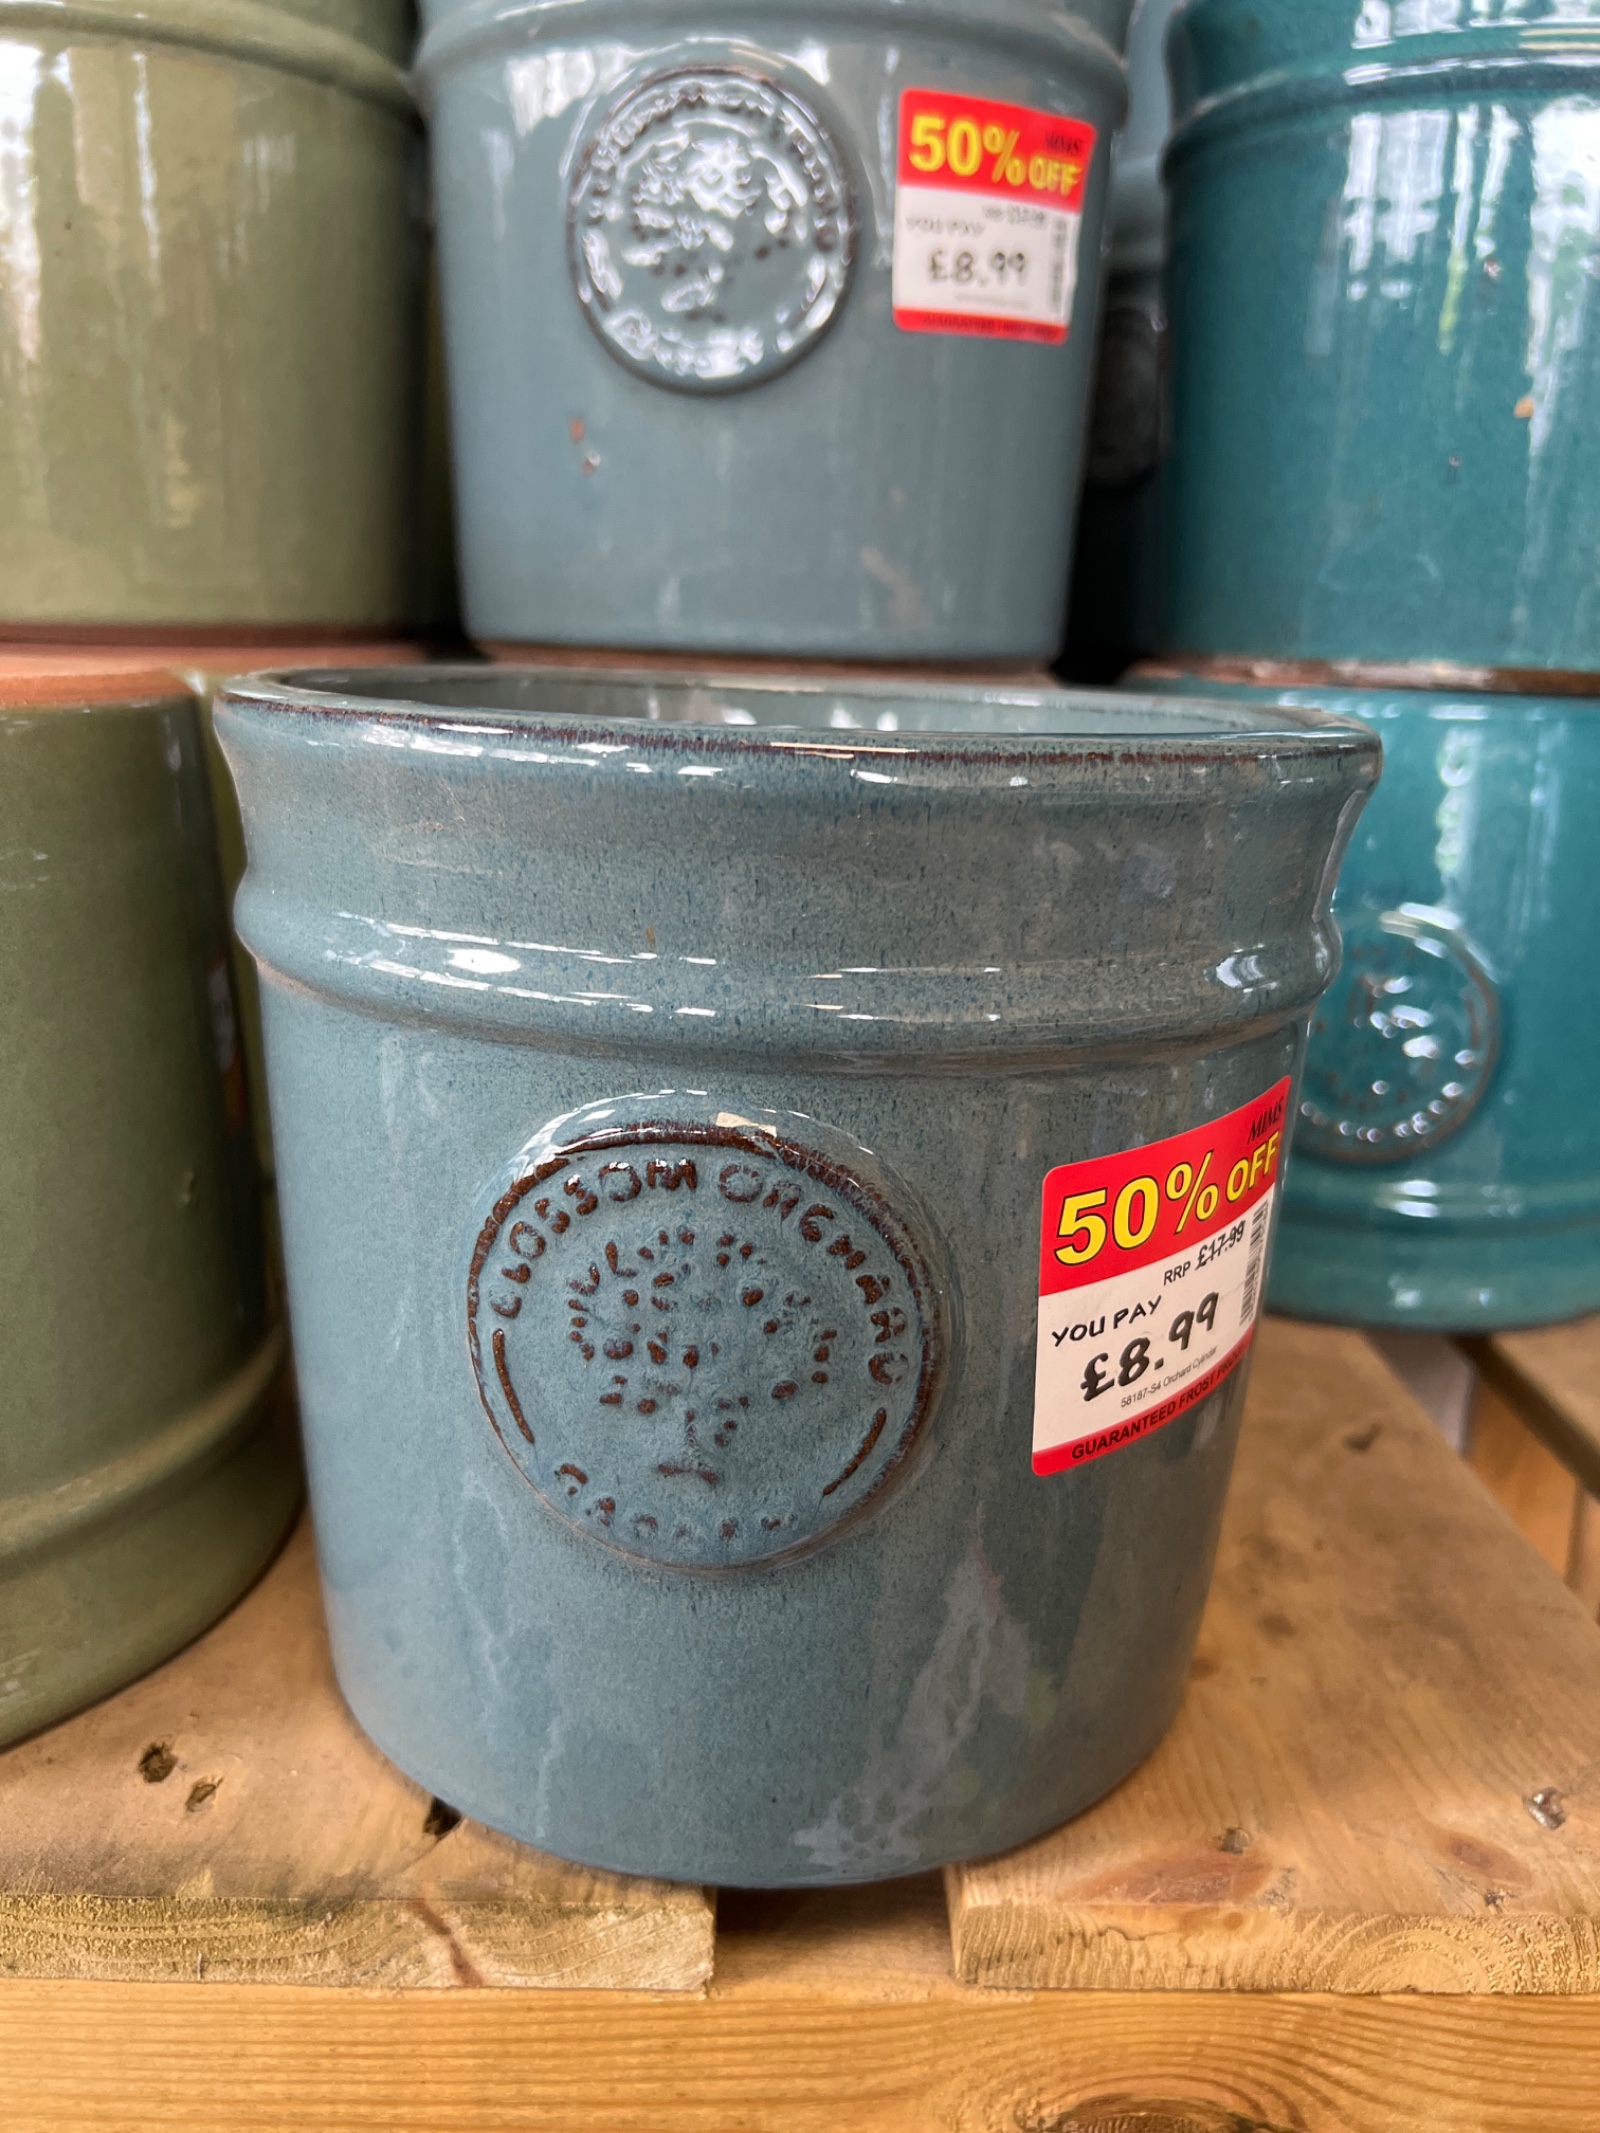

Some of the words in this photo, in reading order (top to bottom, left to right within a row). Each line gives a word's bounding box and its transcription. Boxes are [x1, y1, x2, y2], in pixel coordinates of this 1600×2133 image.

[908, 114, 1027, 187] 50%
[1028, 156, 1083, 197] OFF
[929, 250, 1027, 287] £8.99
[1054, 1149, 1219, 1265] 50%
[1226, 1130, 1279, 1203] OFF
[1164, 1261, 1191, 1286] RRP
[1195, 1219, 1246, 1271] £17.99
[1051, 1316, 1106, 1347] YOU
[1113, 1295, 1162, 1330] PAY
[1080, 1292, 1219, 1402] £8.99
[1071, 1402, 1176, 1460] GUARANTEED
[1179, 1373, 1219, 1408] FROST
[1120, 1380, 1161, 1408] 58187-S4
[1163, 1363, 1191, 1387] Orchard
